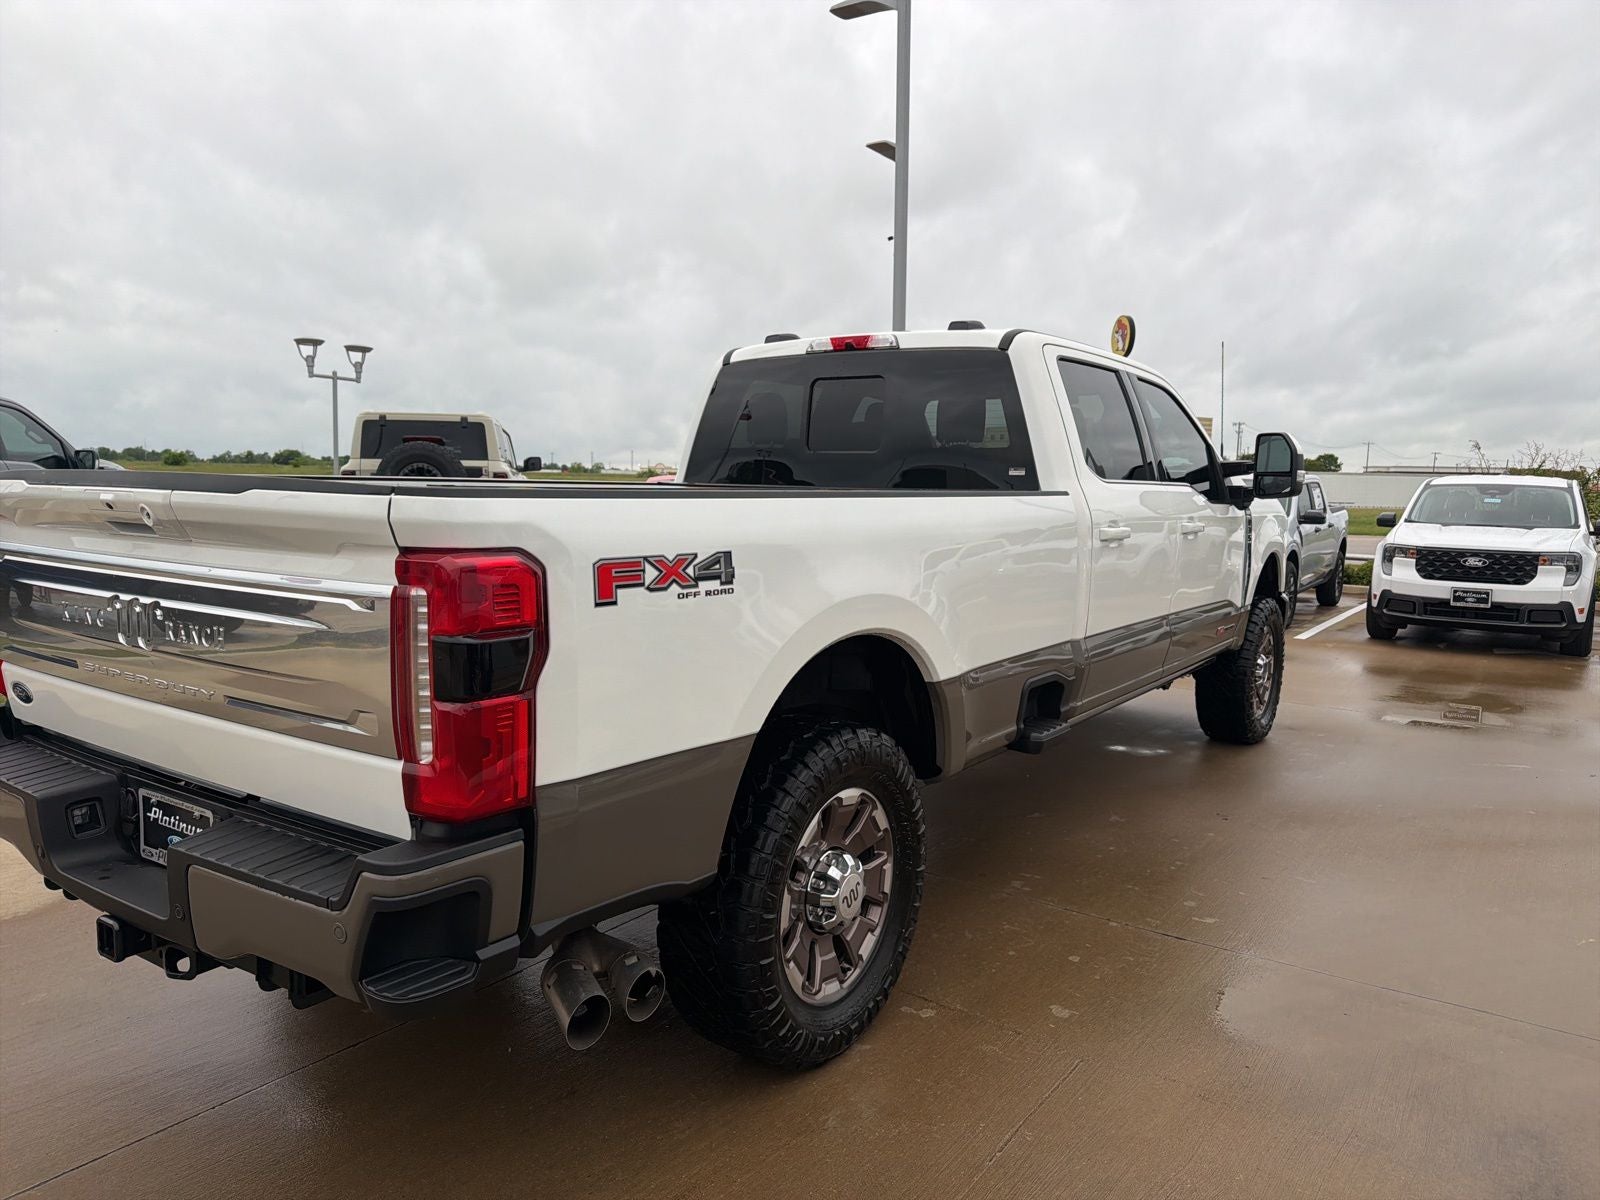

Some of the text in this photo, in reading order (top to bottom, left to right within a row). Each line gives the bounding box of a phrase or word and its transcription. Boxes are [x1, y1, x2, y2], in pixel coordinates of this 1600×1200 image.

[1464, 558, 1485, 566] Ford
[592, 550, 735, 608] FX4
[677, 587, 735, 600] OFF ROAD
[62, 601, 225, 650] KING RANCH
[84, 662, 216, 700] SUPER DUTY
[147, 807, 203, 836] Platinu
